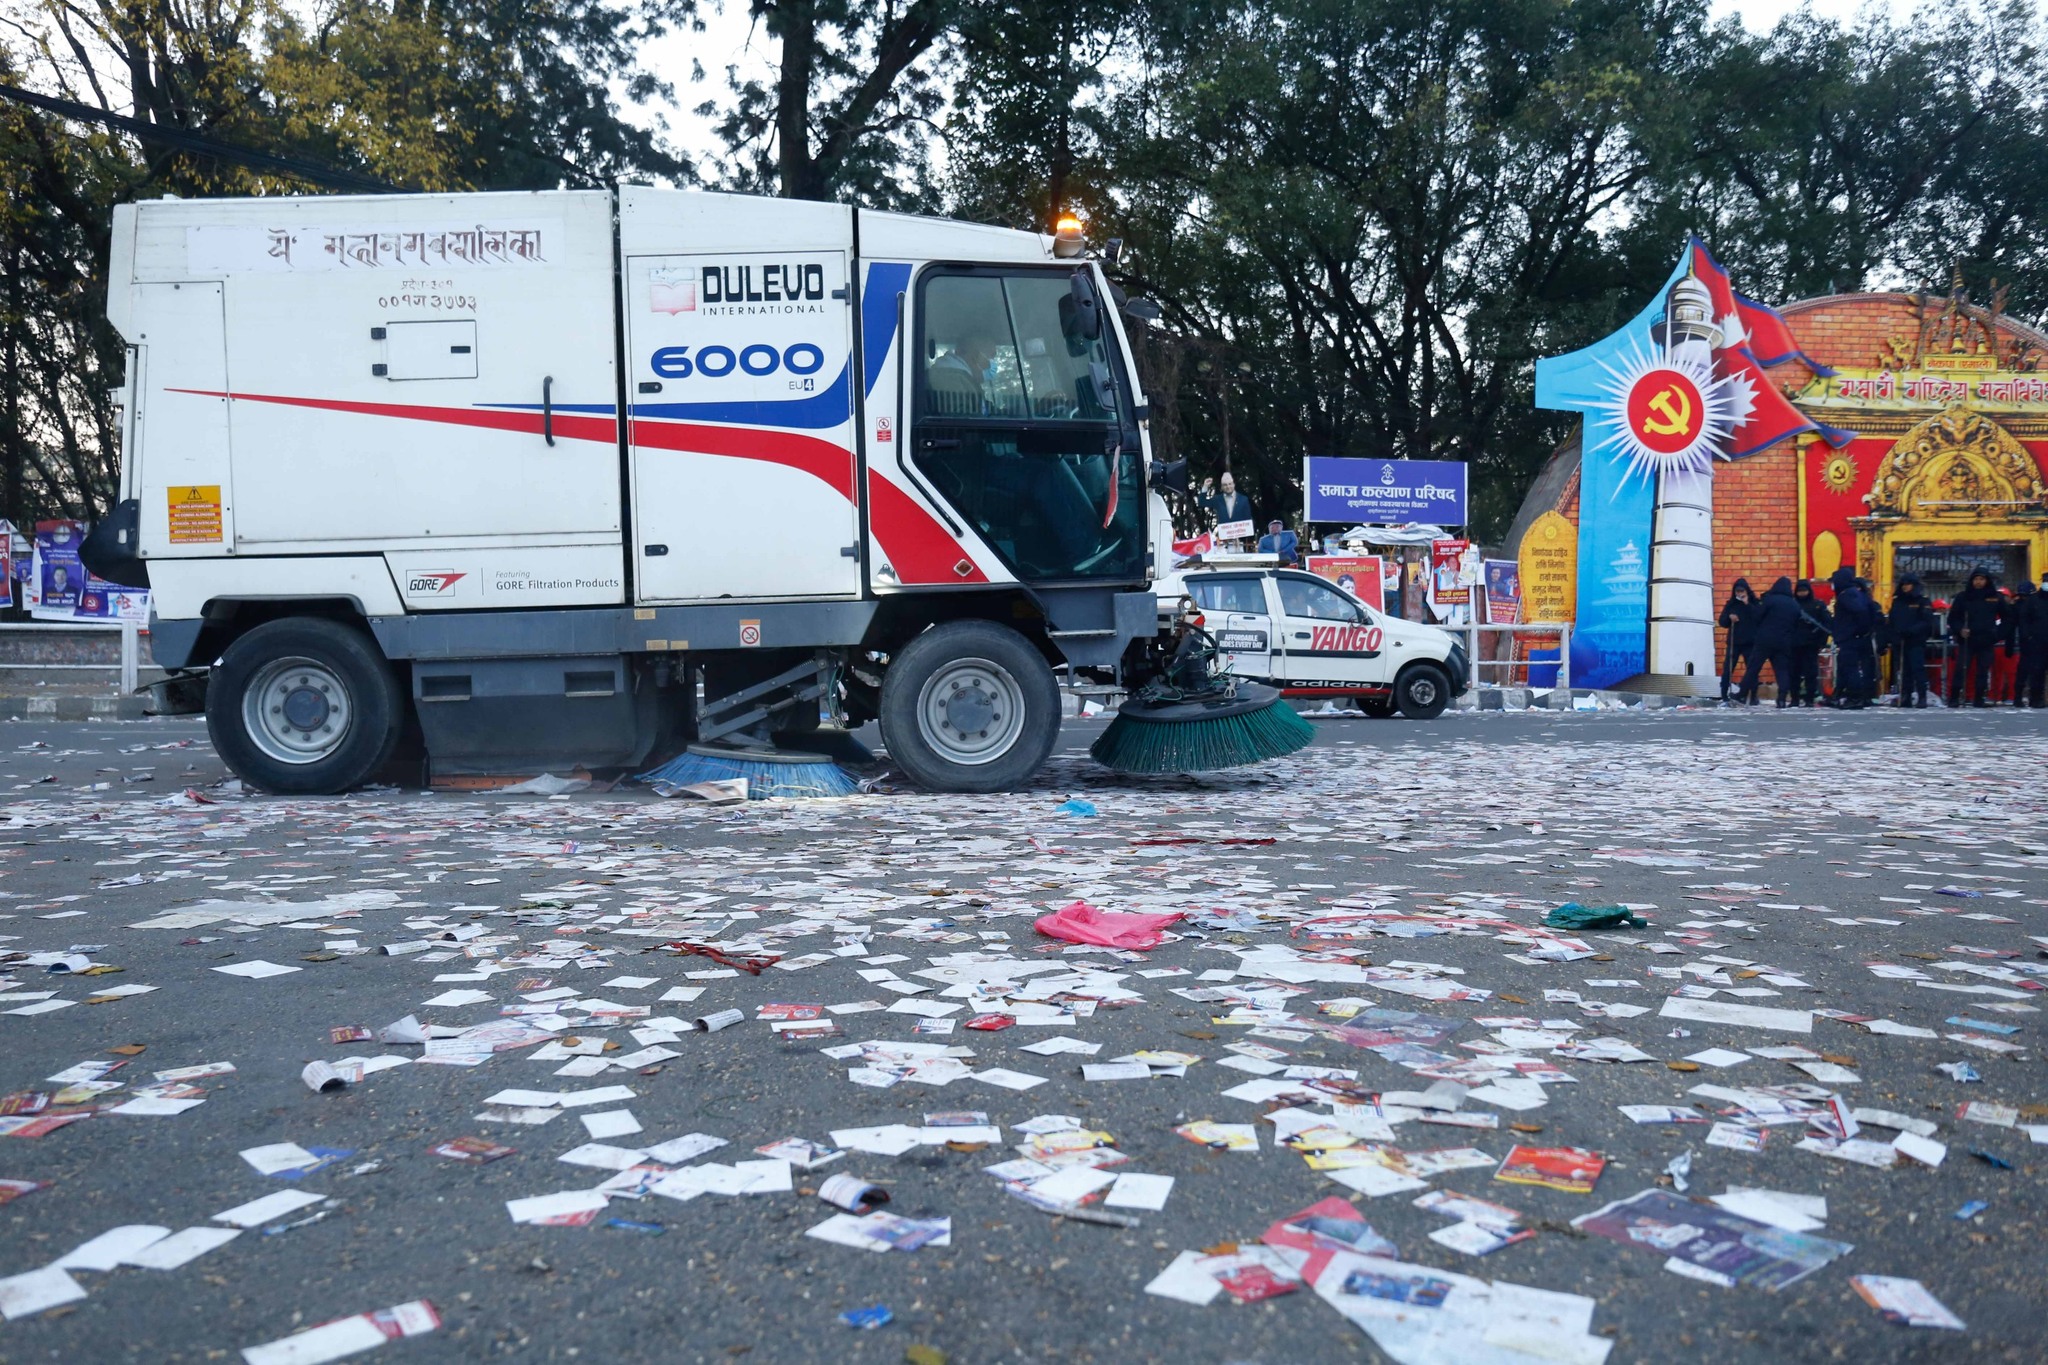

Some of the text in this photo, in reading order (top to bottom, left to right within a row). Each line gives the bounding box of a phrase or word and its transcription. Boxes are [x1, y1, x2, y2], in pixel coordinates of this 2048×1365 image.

[702, 264, 823, 303] DULEVO
[703, 304, 825, 316] INTERNATIONAL
[651, 343, 824, 379] 6000
[789, 378, 814, 391] EU4
[1318, 484, 1358, 497] समाज
[1361, 486, 1411, 499] कल्याण
[496, 571, 531, 579] Featuring
[409, 578, 439, 591] GORE
[528, 579, 572, 589] Filtration
[575, 577, 619, 588] Products
[1310, 626, 1382, 652] YANGO
[1291, 680, 1372, 688] adidas
